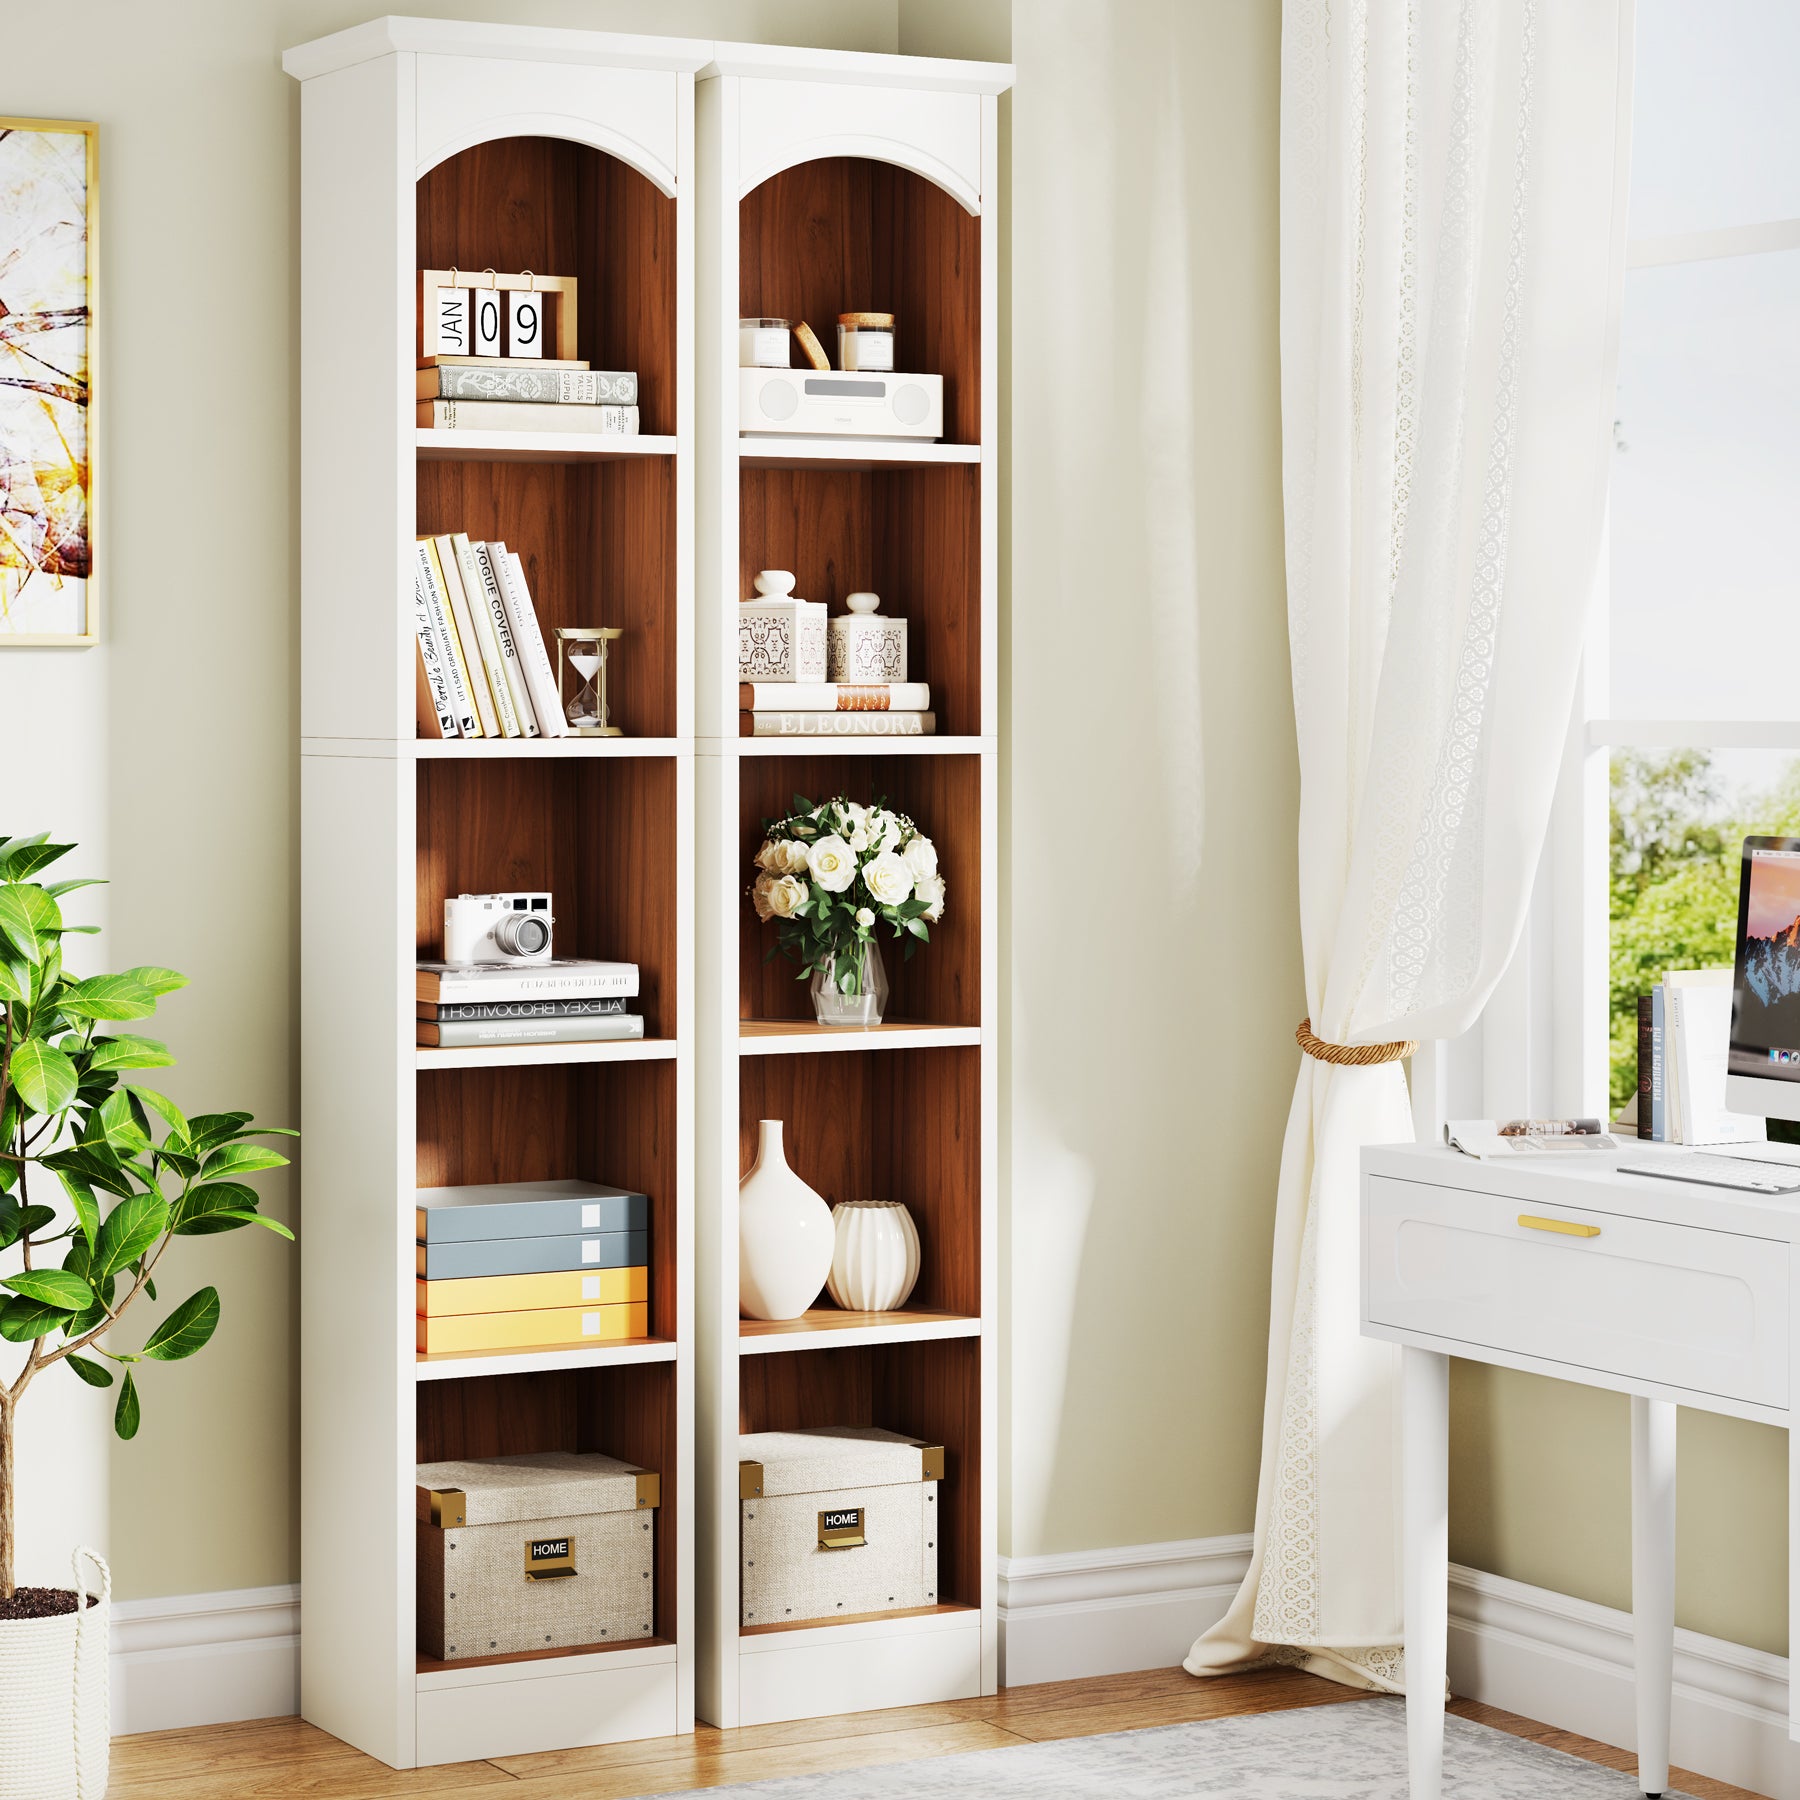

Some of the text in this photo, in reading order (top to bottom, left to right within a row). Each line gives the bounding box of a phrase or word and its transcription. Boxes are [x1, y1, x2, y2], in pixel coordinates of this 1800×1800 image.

[441, 301, 463, 347] JAN
[563, 373, 571, 401] CUPID
[419, 548, 428, 565] 2014
[423, 567, 434, 590] SHOW
[475, 545, 497, 595] VOGUE
[491, 599, 515, 658] COVERS
[440, 627, 456, 668] GRADUATE
[779, 713, 924, 734] ELEONORA
[826, 1513, 858, 1526] HOME
[533, 1542, 567, 1556] HOME
